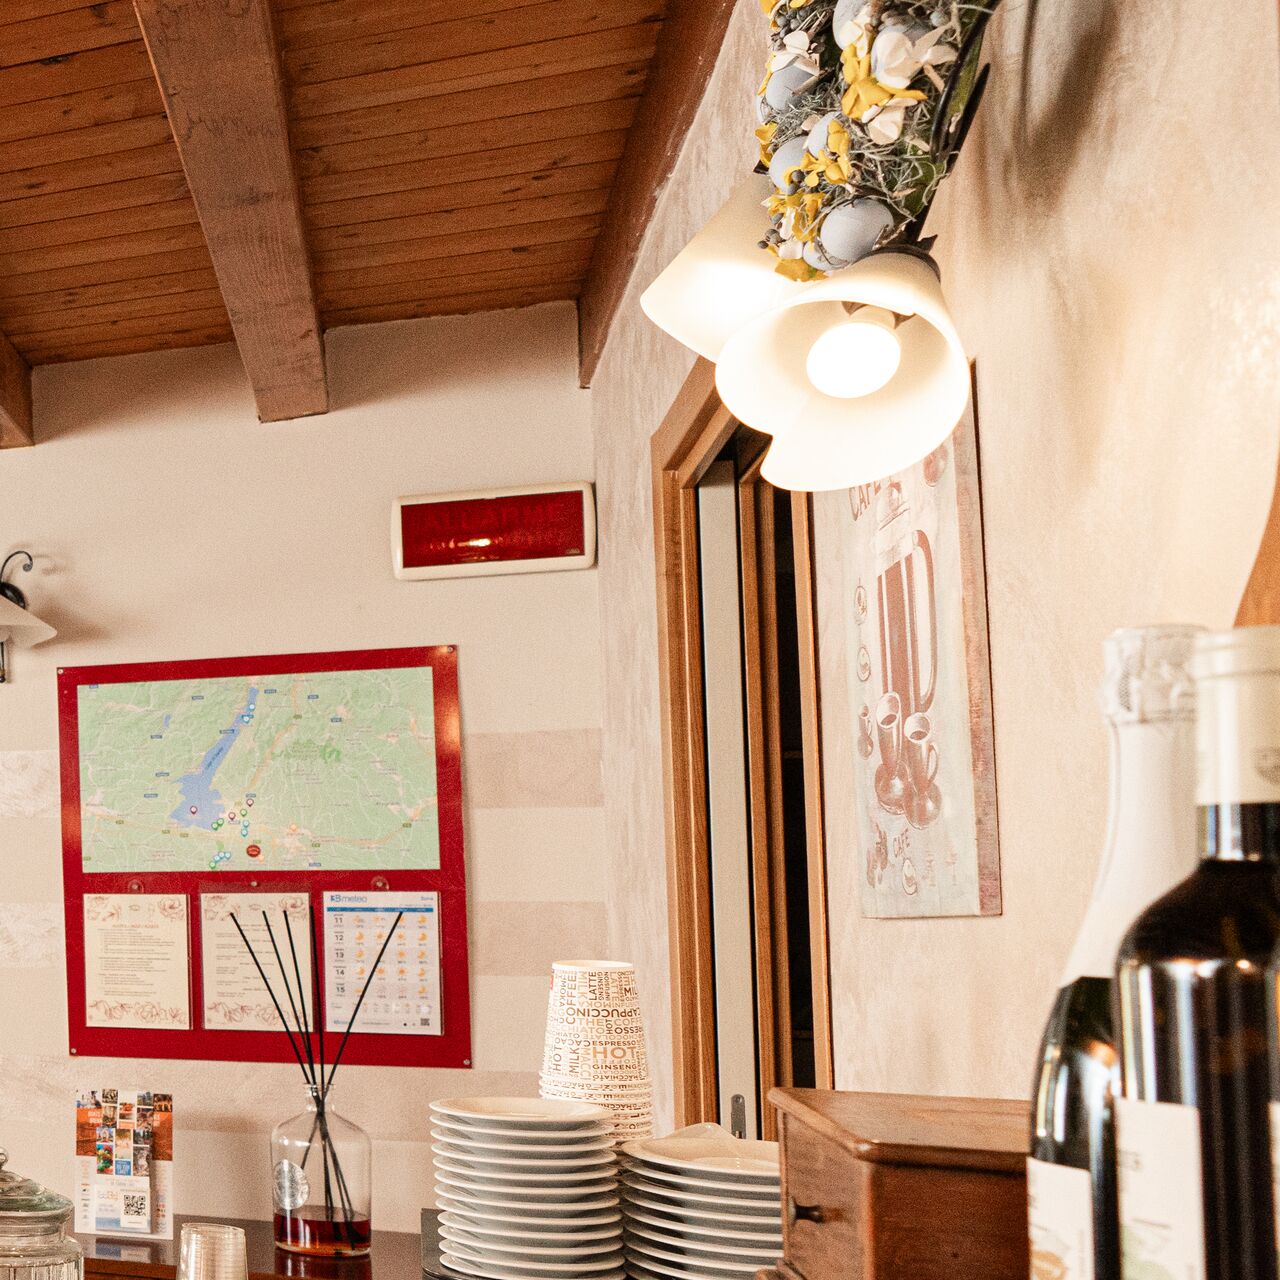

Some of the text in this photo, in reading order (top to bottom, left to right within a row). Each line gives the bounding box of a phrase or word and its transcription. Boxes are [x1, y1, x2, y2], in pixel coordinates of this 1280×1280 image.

[589, 972, 597, 1000] LATTE
[566, 975, 577, 1024] COFFEE
[553, 1045, 562, 1071] HOT
[569, 1048, 579, 1073] MILK
[593, 1047, 636, 1059] HOT
